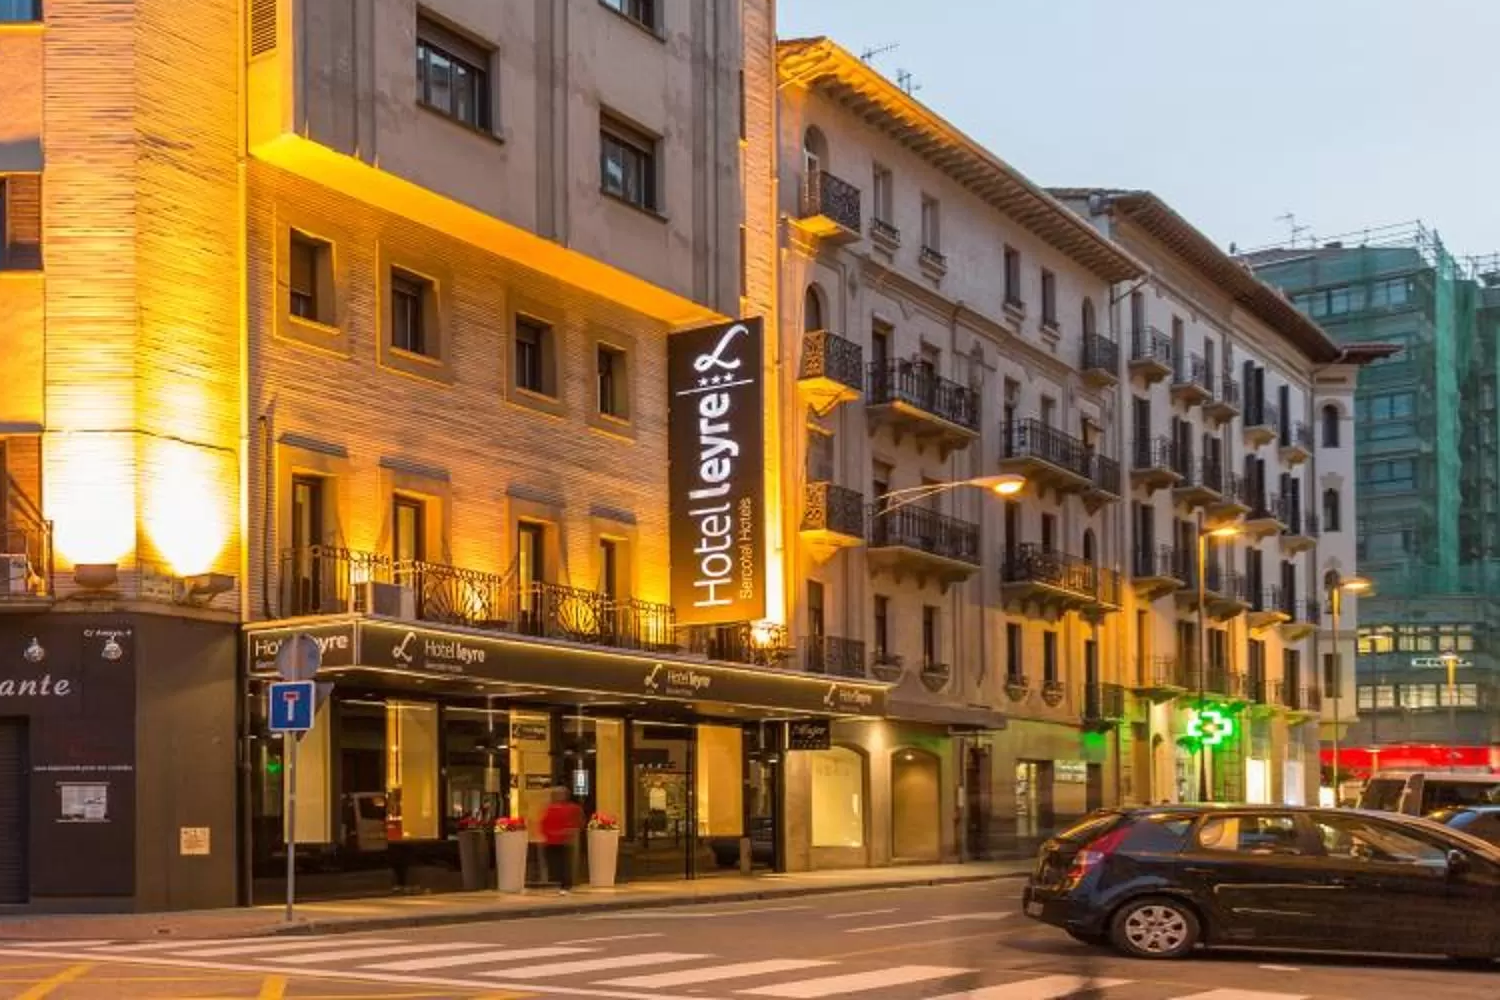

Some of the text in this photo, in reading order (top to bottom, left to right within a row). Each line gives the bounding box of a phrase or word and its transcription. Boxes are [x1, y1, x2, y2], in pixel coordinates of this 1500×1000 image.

[688, 392, 740, 608] Hotel leyre
[739, 498, 752, 541] Hotels
[425, 639, 485, 664] Hotel leyre
